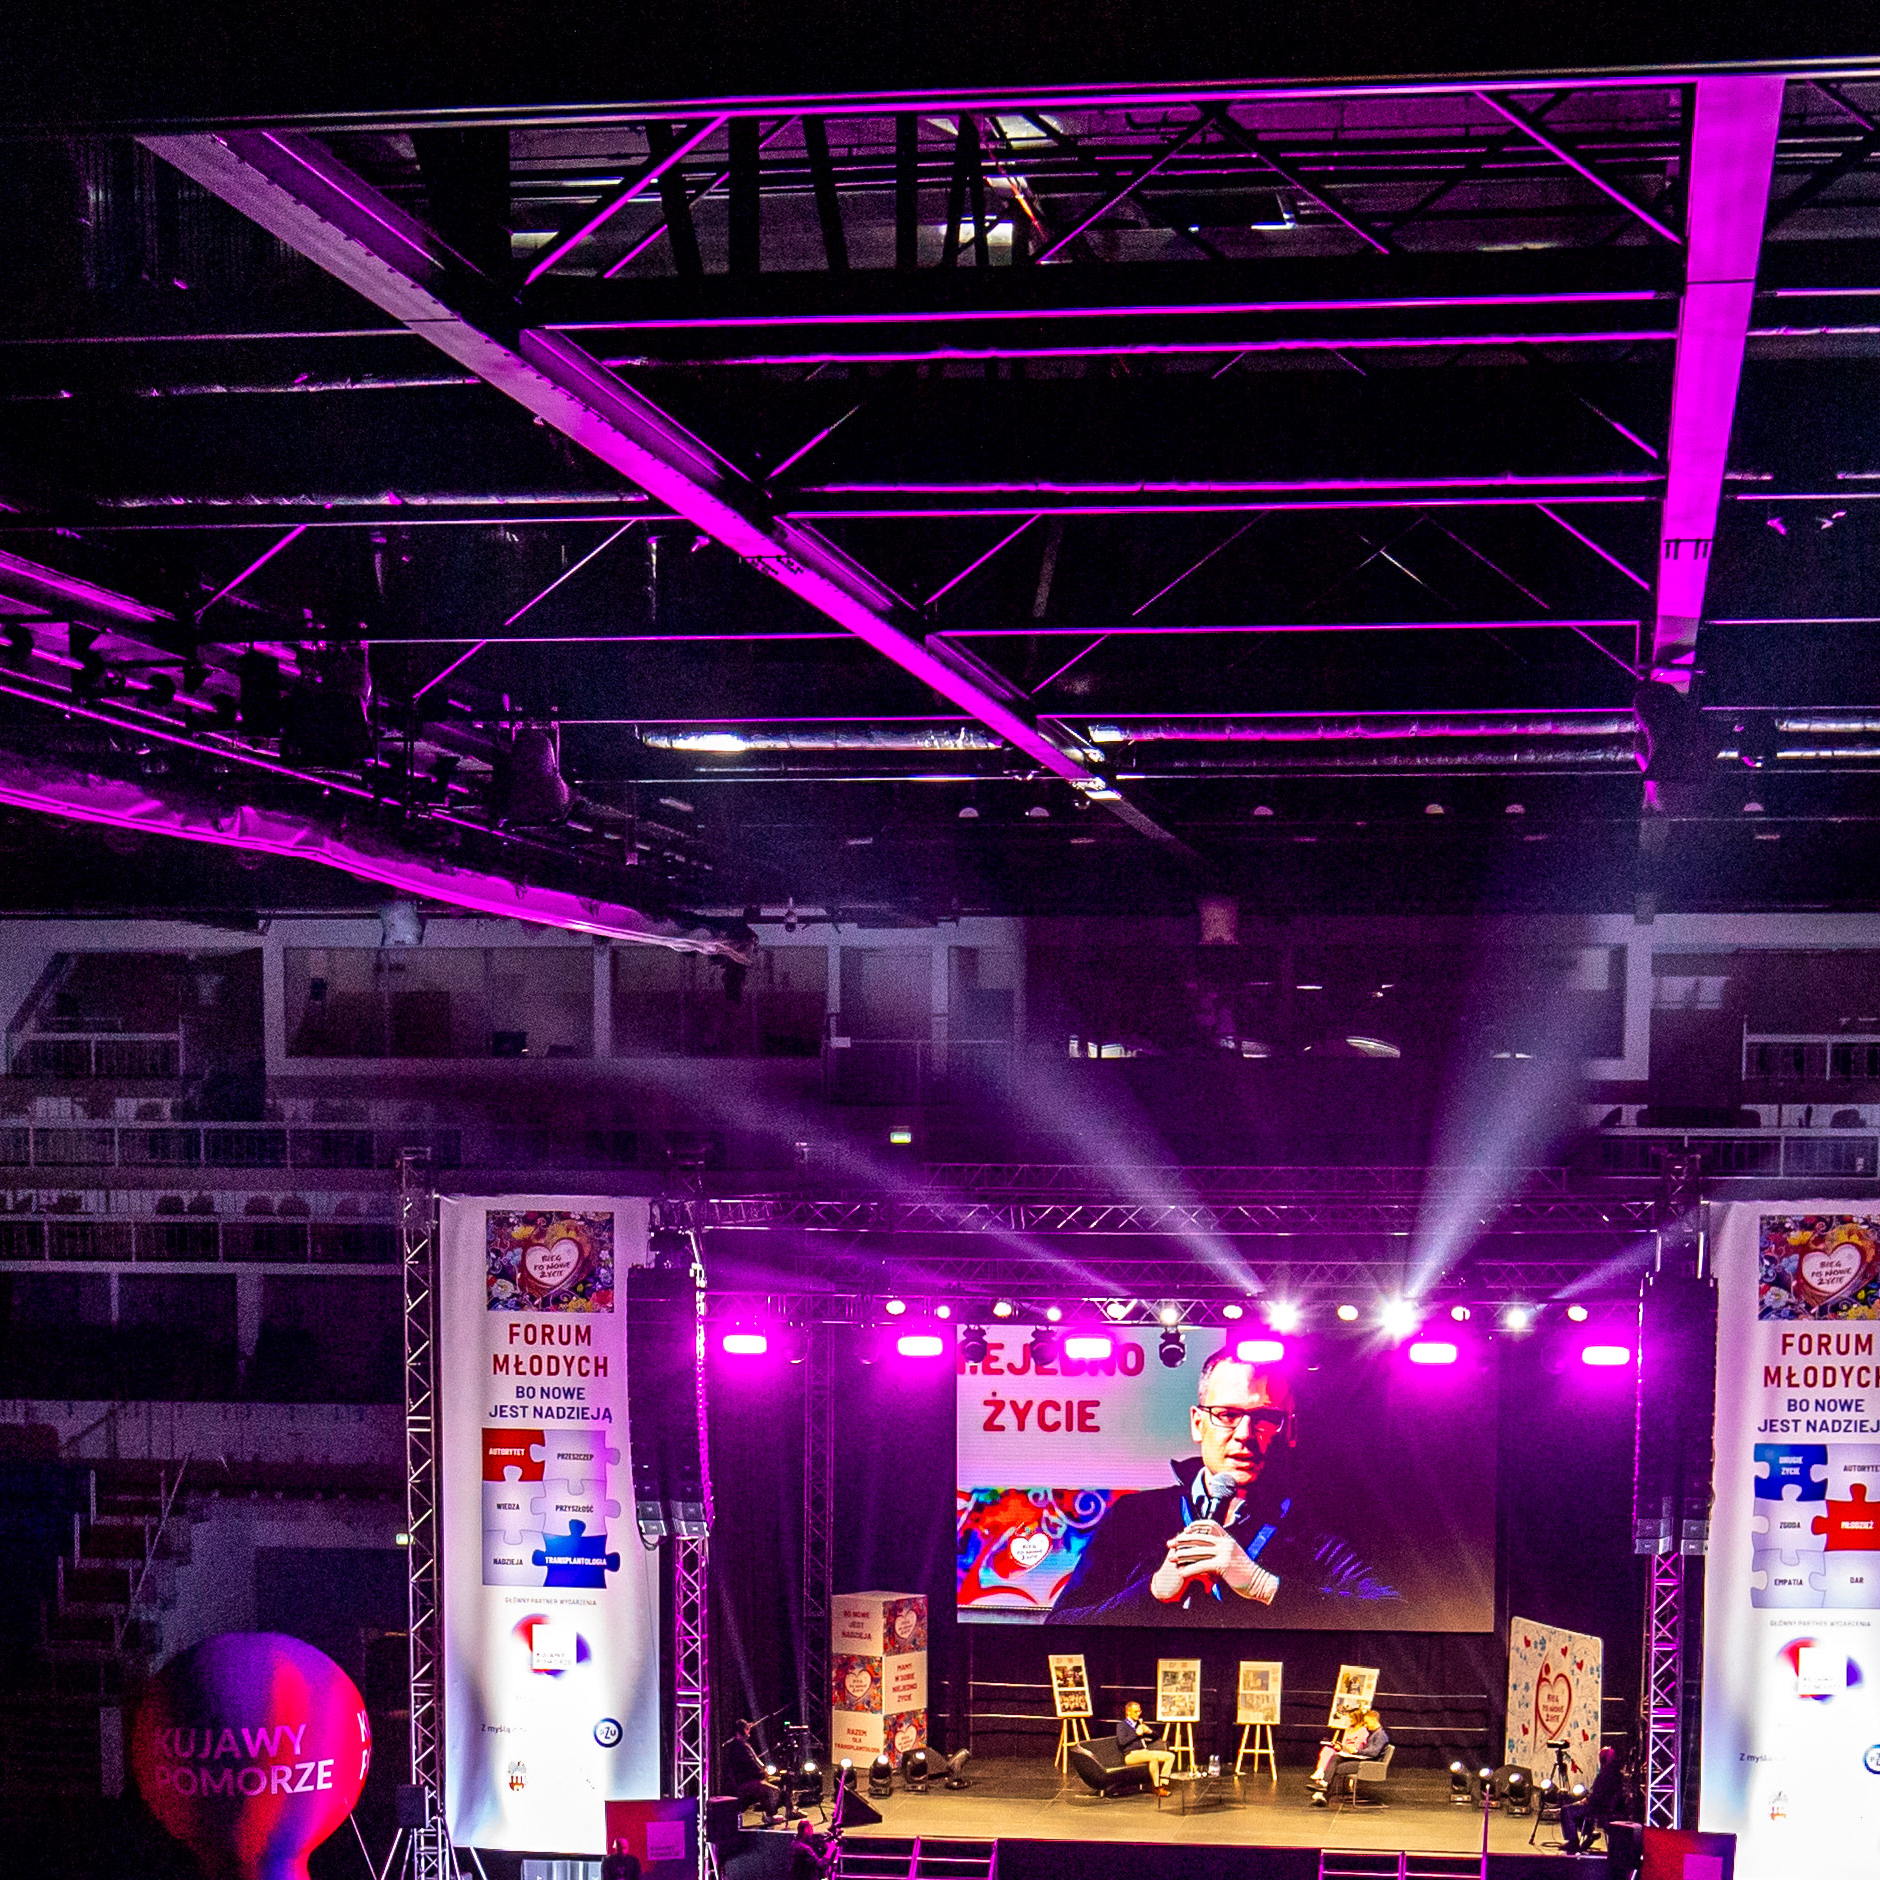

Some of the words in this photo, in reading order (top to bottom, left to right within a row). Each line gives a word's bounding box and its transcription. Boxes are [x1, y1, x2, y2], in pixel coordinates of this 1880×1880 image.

[508, 1323, 591, 1346] FORUM
[1781, 1333, 1873, 1356] FORUM
[492, 1353, 608, 1377] MŁODYCH
[515, 1385, 536, 1399] BO
[540, 1386, 586, 1400] NOWE
[488, 1405, 529, 1418] JEST
[533, 1406, 613, 1424] NADZIEJĄ
[982, 1390, 1101, 1433] ŻYCIE
[1787, 1399, 1810, 1412] BO
[1814, 1399, 1865, 1412] NOWE
[1757, 1419, 1801, 1432] JEST
[488, 1448, 525, 1456] AUTORYTET
[557, 1453, 594, 1461] PRZESZCZEP
[496, 1503, 520, 1511] WIEDZA
[156, 1724, 306, 1760] KUJAWY
[155, 1759, 334, 1796] POMORZE
